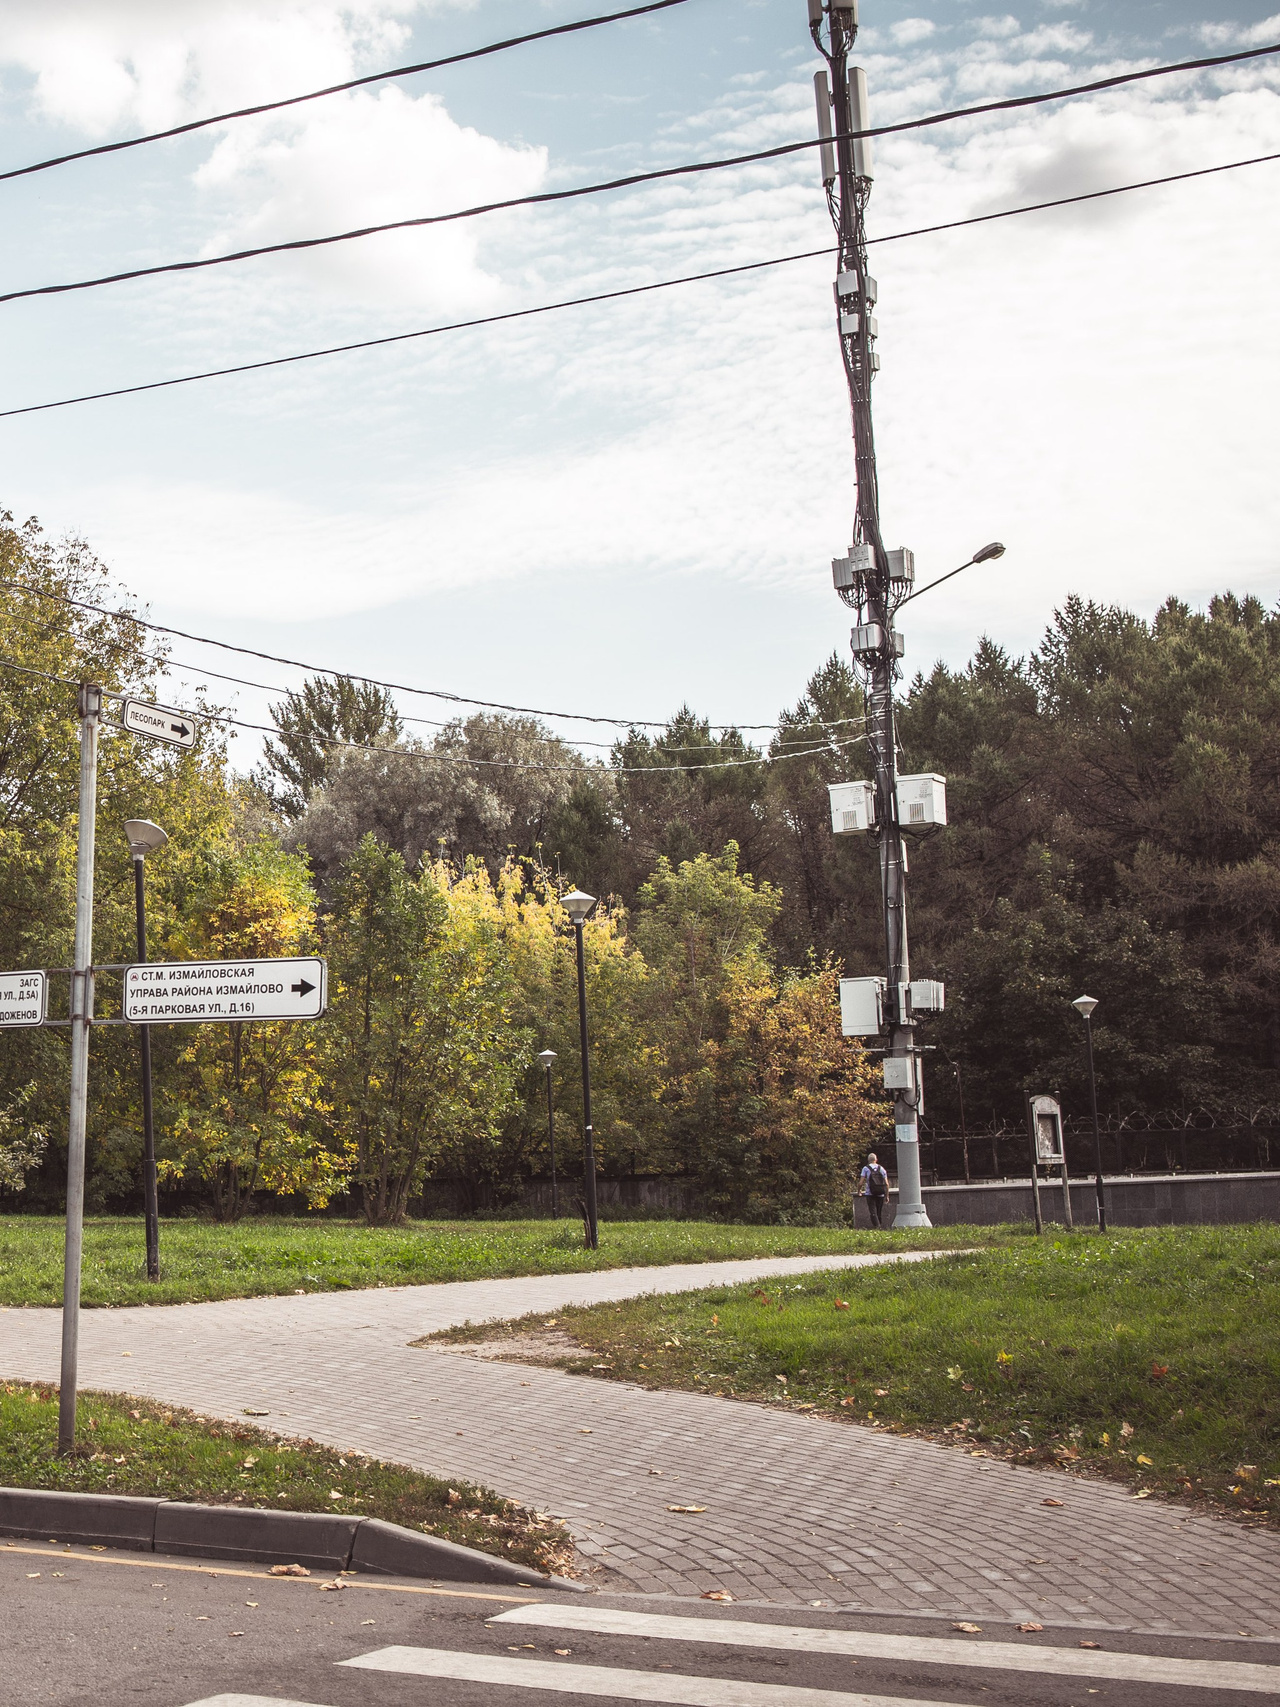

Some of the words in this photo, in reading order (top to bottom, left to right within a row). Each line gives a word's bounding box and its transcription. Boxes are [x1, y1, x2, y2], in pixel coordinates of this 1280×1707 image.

[130, 711, 166, 729] ЛЕСОПАРК
[141, 971, 166, 981] СТ.М.
[169, 967, 254, 980] ИЗМАЙЛОВСКАЯ
[19, 978, 39, 987] ЗАГС
[3, 991, 17, 1001] УЛ.,
[18, 990, 38, 1001] Д.5А)
[130, 988, 168, 998] УПРАВА
[171, 985, 213, 997] РАЙОНА
[216, 983, 284, 995] ИЗМАЙЛОВО
[129, 1005, 148, 1016] (5-Я
[151, 1004, 205, 1015] ПАРКОВАЯ
[208, 1003, 226, 1014] УЛ.,
[229, 1002, 255, 1014] Д.16)
